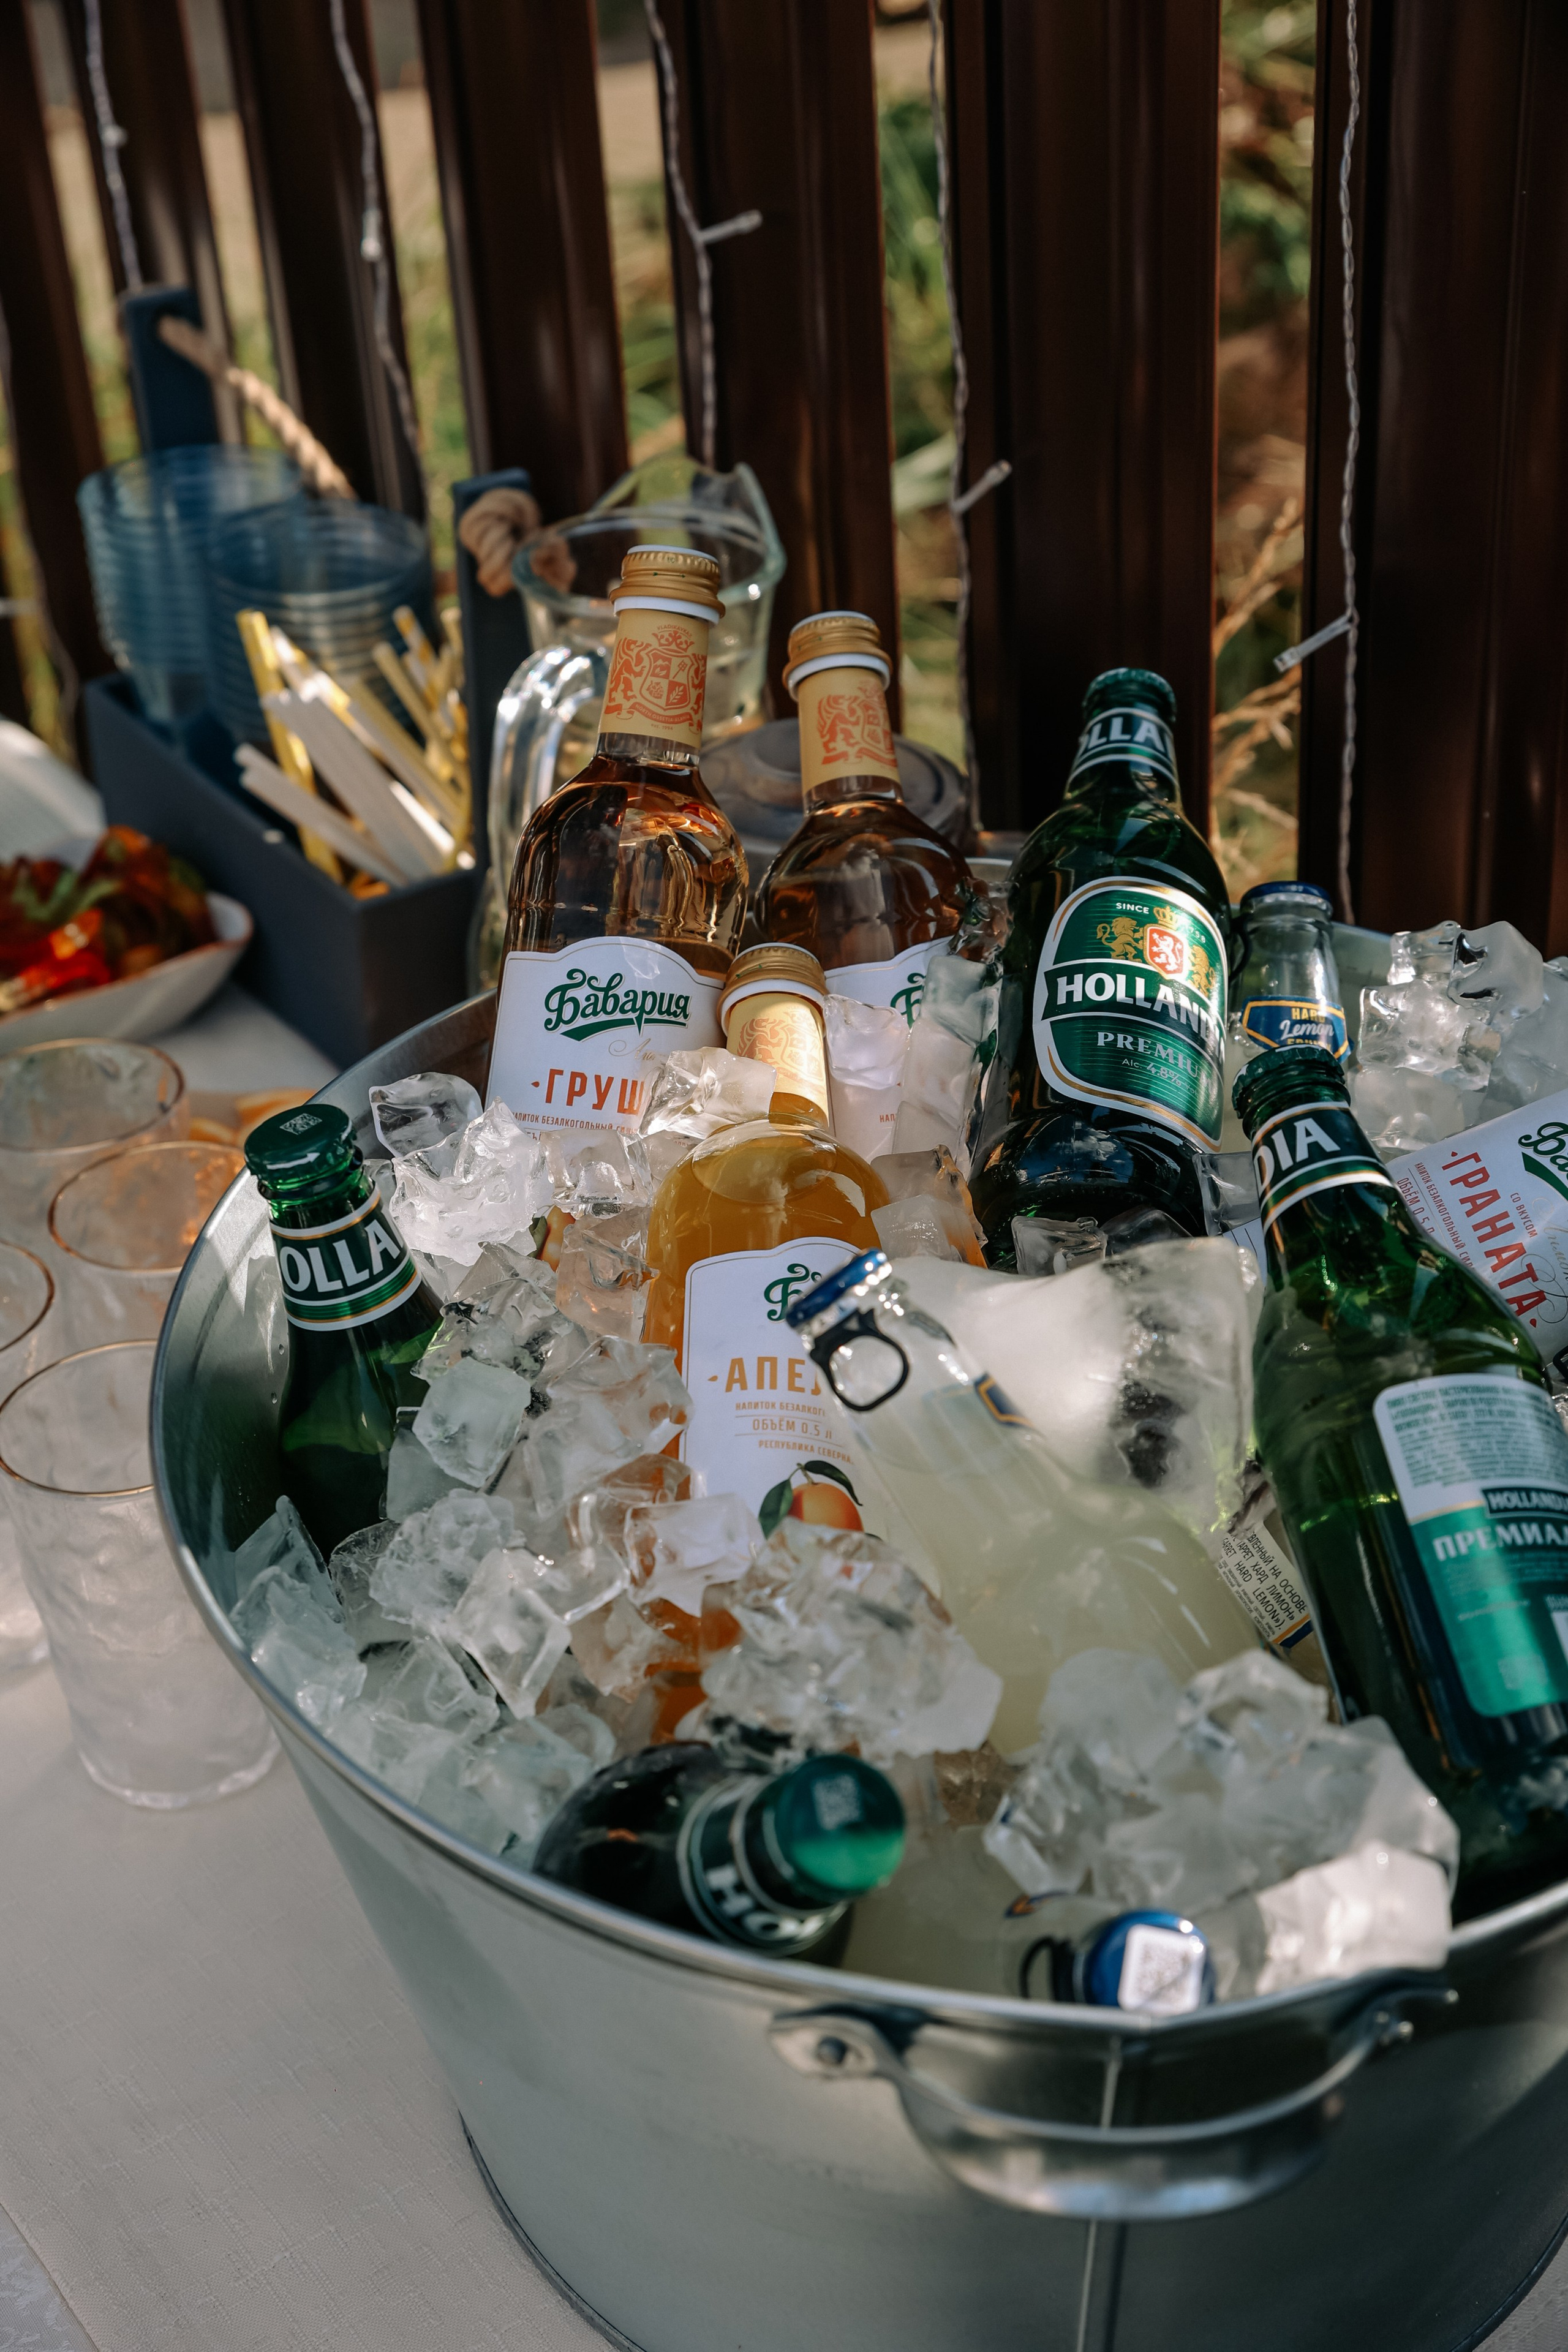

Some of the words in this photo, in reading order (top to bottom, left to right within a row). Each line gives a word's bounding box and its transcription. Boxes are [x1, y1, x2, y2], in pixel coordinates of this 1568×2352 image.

[1115, 902, 1150, 914] SINCE
[544, 968, 690, 1035] Бавария
[1291, 1008, 1325, 1023] HARD
[1279, 1019, 1335, 1040] Lemon
[1121, 1058, 1142, 1069] Alc.
[1146, 1062, 1182, 1086] 4.8%
[545, 1068, 646, 1115] ГРУШ
[541, 1117, 613, 1130] БЕЗАЛКОГОЛЬНЫЙ
[880, 1114, 895, 1123] НАП
[1397, 1177, 1421, 1206] ОБЪЁМ
[1510, 1192, 1521, 1204] СО
[1414, 1162, 1433, 1185] НАПИТОК
[1426, 1183, 1466, 1250] БЕЗАЛКОГОЛЬНЫЙ
[1459, 1251, 1475, 1269] СИЛ
[1515, 1204, 1539, 1239] ВКУСОМ
[1442, 1152, 1547, 1317] ГРАНАТА
[736, 1401, 776, 1411] НАПИТОК
[752, 1417, 796, 1432] ОБЪЁМ
[801, 1422, 820, 1436] 0.5
[758, 1439, 815, 1453] РЕСПУБЛИКА
[818, 1447, 855, 1465] СЕВЕРНА
[1234, 1560, 1253, 1583] HARD
[1247, 1531, 1275, 1566] ВЛЕННЫЙ
[1269, 1565, 1283, 1580] НА
[1279, 1578, 1307, 1614] ОСНОВЕ
[1250, 1561, 1269, 1585] ХАРД
